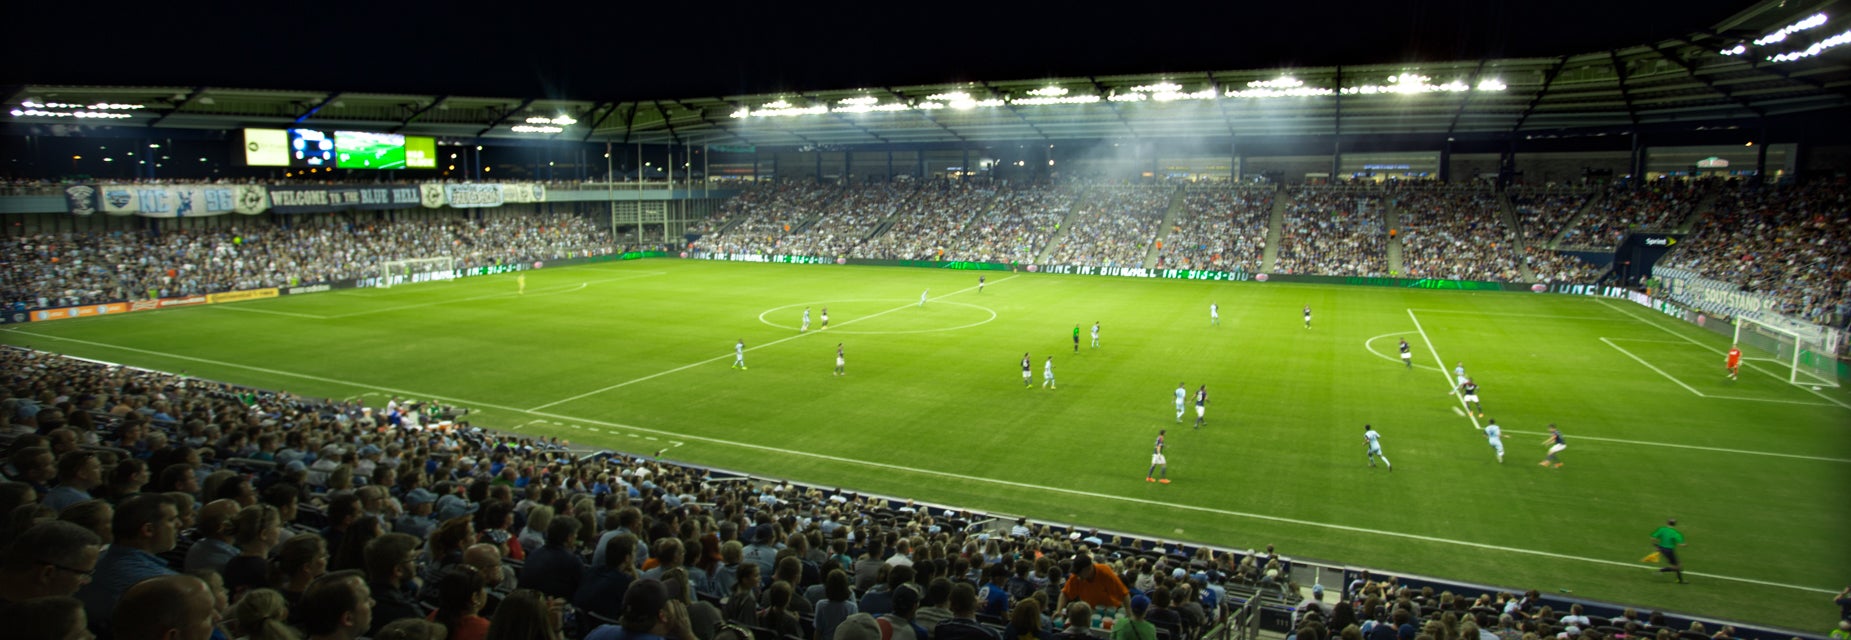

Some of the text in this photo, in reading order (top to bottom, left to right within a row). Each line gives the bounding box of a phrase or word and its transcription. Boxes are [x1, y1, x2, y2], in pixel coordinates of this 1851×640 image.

[137, 188, 171, 213] KC
[204, 188, 233, 212] 96
[270, 188, 420, 206] WELCOME TO THE BLUE HELL
[1645, 237, 1667, 246] Sprint
